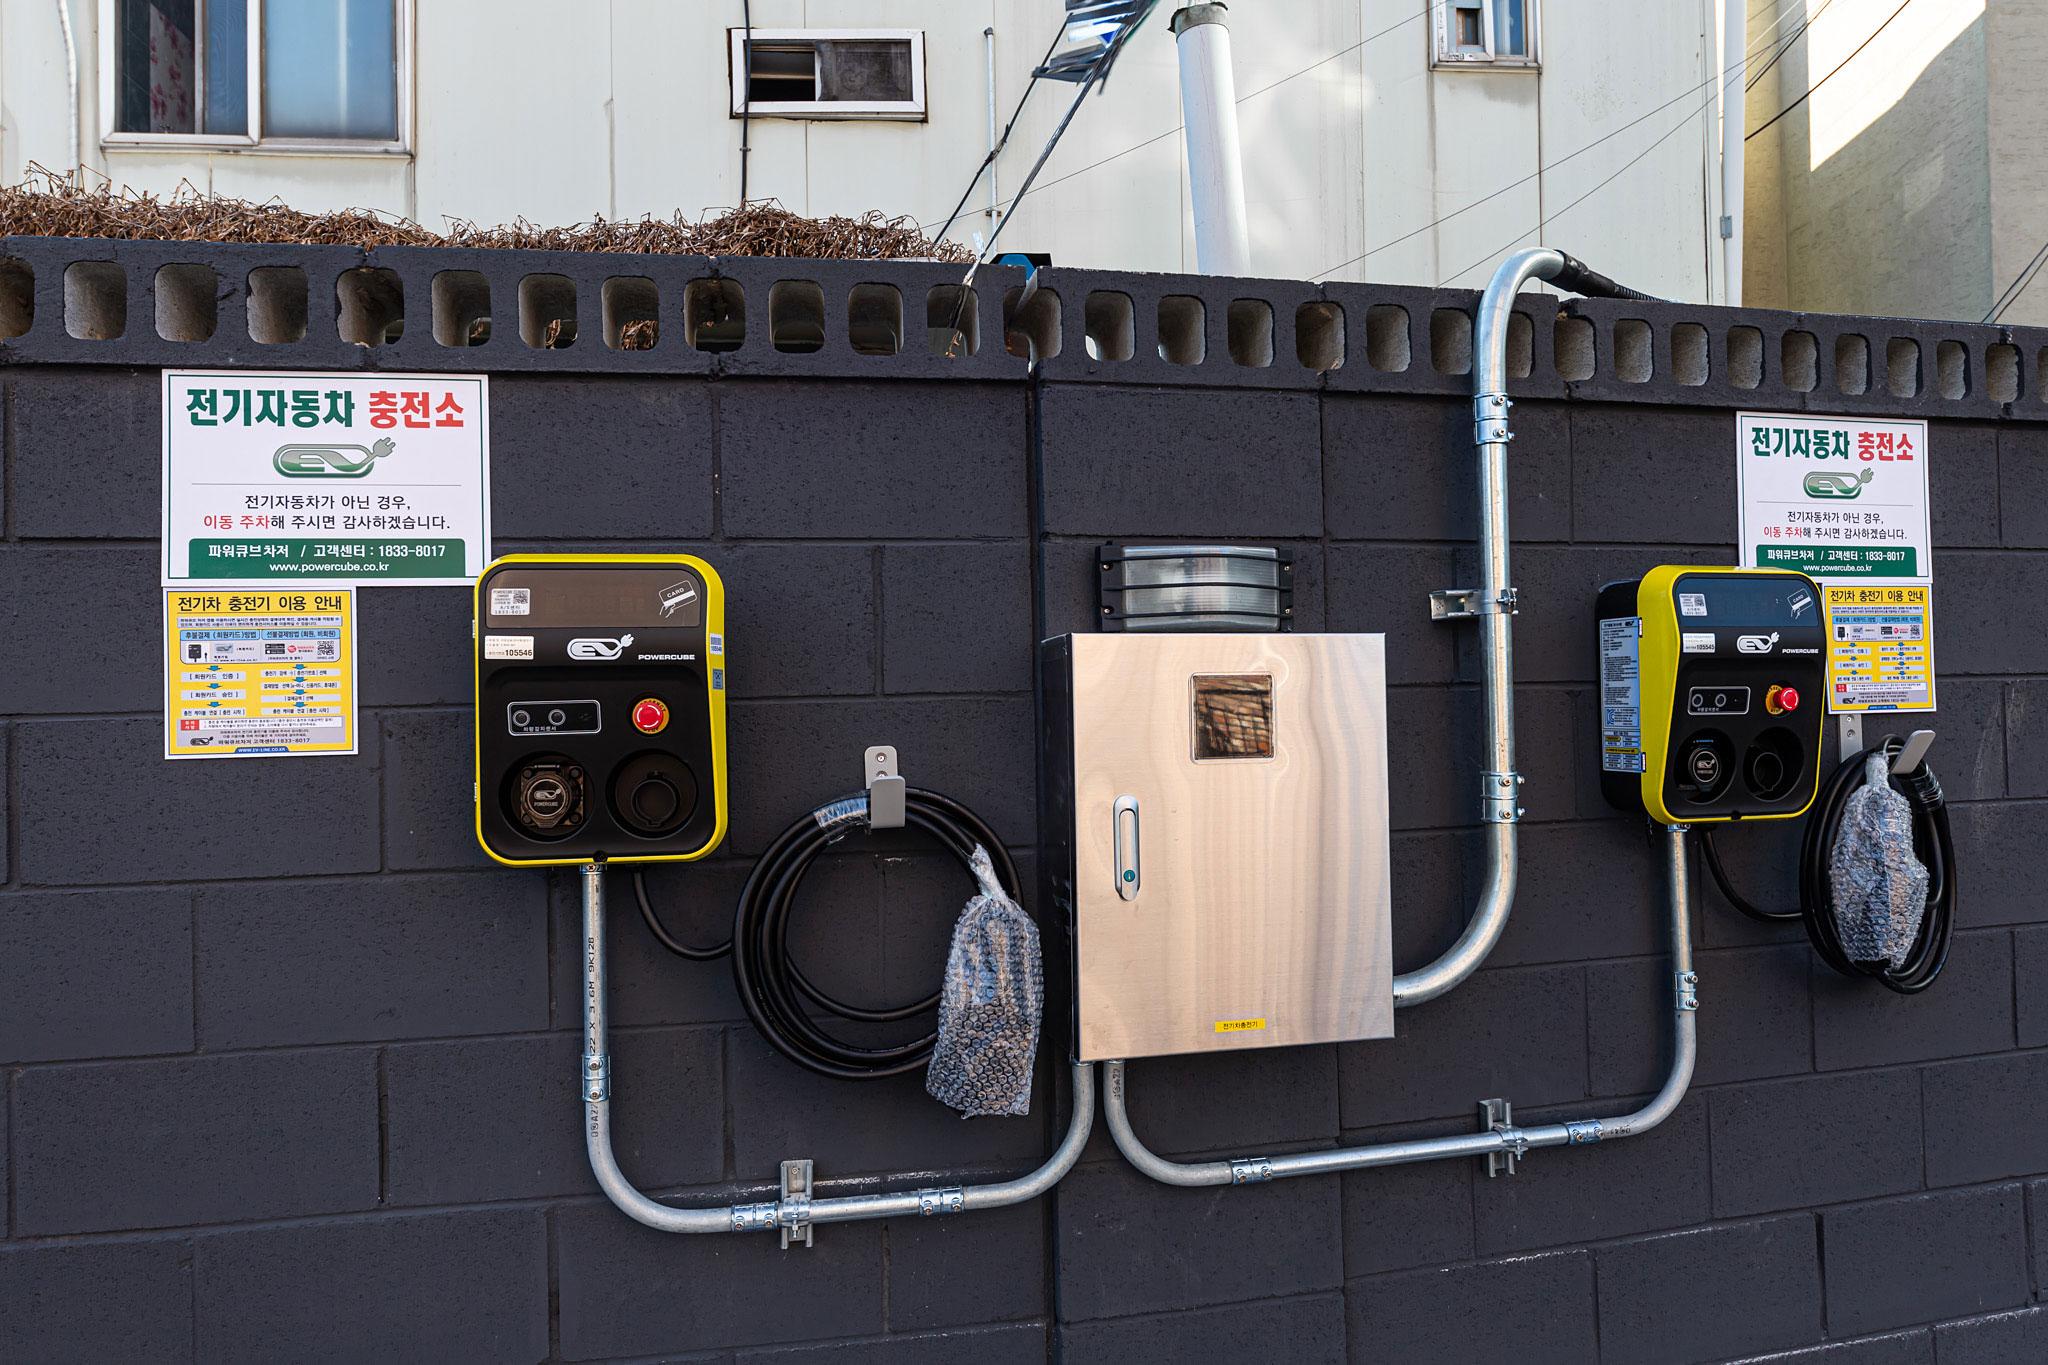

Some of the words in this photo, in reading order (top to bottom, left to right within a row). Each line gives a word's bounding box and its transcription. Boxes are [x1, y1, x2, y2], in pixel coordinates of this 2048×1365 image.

[186, 388, 355, 428] 전기자동차
[368, 390, 465, 429] 충전소
[1751, 427, 1850, 459] 전기자동차
[1858, 431, 1914, 461] 충전소
[244, 495, 335, 509] 전기자동차가
[341, 495, 370, 509] 아닌
[376, 495, 411, 511] 경우,
[203, 515, 233, 530] 이동
[239, 515, 285, 530] 주차해
[291, 515, 336, 530] 주시면
[342, 515, 451, 530] 감사하겠습니다.
[1787, 511, 1839, 524] 전기자동차가
[1843, 513, 1860, 524] 아닌
[1863, 513, 1884, 525] 경우,
[1763, 527, 1781, 538] 이동
[1785, 527, 1811, 538] 주차해
[1814, 528, 1840, 539] 주시면
[1844, 529, 1908, 540] 감사하겠습니다.
[313, 544, 367, 558] 고객센터
[378, 545, 446, 558] 1833-8017
[1865, 551, 1905, 561] 1833-8017
[269, 562, 389, 573] www.powercube.co.kr
[1802, 564, 1872, 573] www.powercube.co.kr
[667, 587, 685, 598] CARD
[1830, 590, 1855, 602] 전기차
[1859, 590, 1883, 602] 충전기
[1887, 590, 1904, 602] 이용
[1907, 590, 1924, 602] 안내
[178, 596, 221, 611] 전기차
[228, 596, 270, 611] 충전기
[279, 596, 306, 611] 이용
[314, 596, 342, 611] 안내
